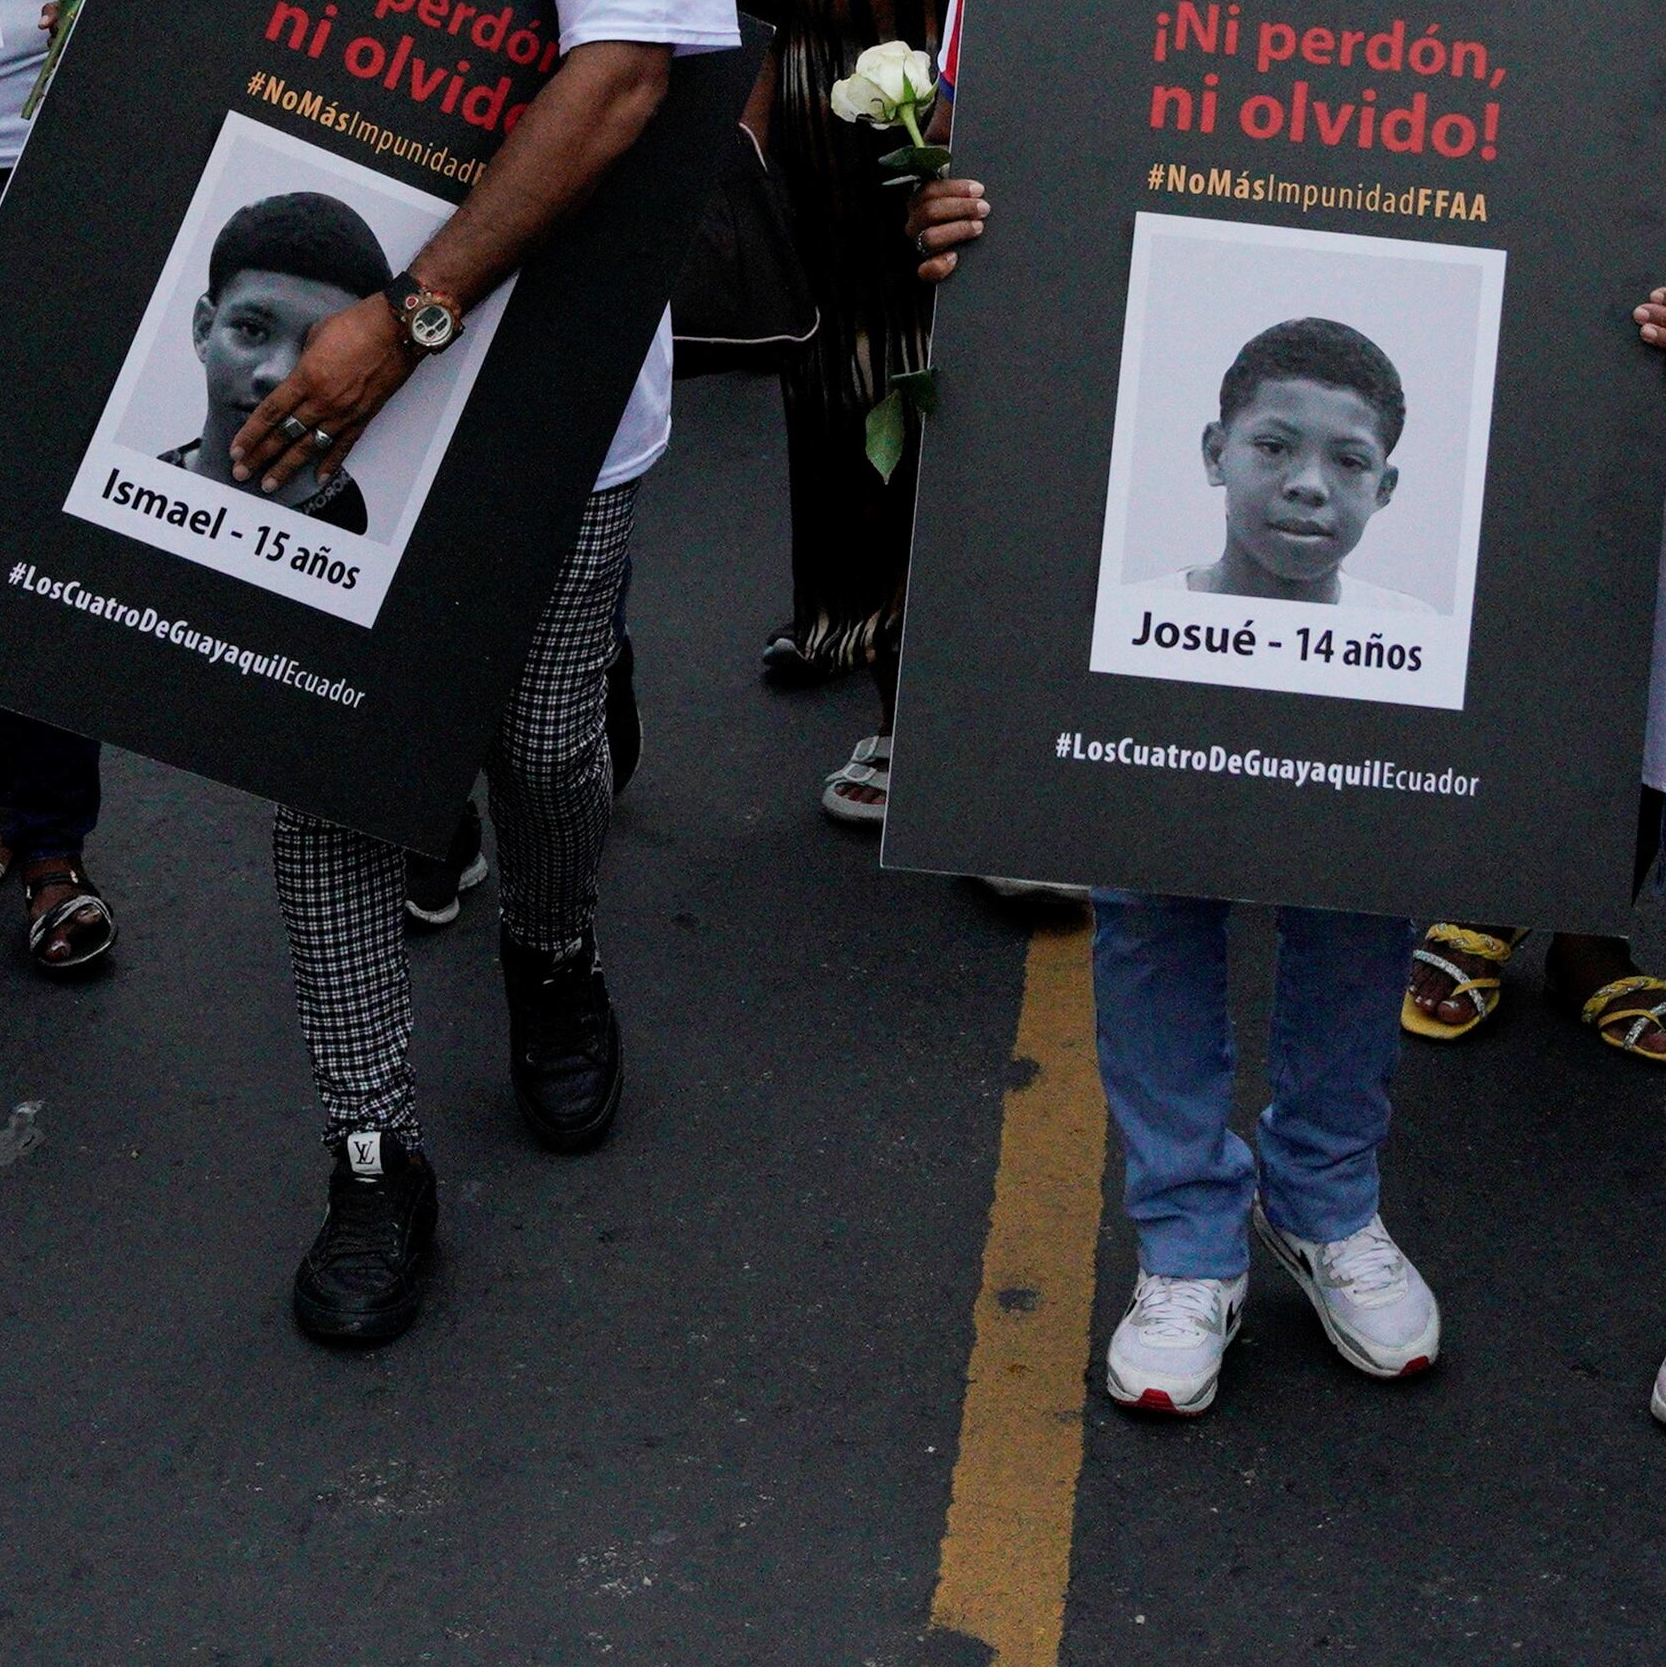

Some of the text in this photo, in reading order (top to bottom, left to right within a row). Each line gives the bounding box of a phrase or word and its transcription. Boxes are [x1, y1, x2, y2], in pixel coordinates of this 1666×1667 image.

[1154, 1, 1505, 88] ¡Ni perdón,
[1150, 73, 1505, 161] ni olvido!
[1149, 166, 1486, 219] #NoMásImpunidadFFAA
[102, 467, 227, 543] Ismael
[252, 521, 290, 564] 15
[290, 543, 361, 591] años
[7, 561, 366, 711] #LosCuatroDeGuayaquilEcuador
[1132, 612, 1255, 655] Josué
[1297, 628, 1334, 662] 14
[1343, 634, 1421, 671] años
[1056, 733, 1479, 795] #LosCuatroDeGuayaquilEcuador
